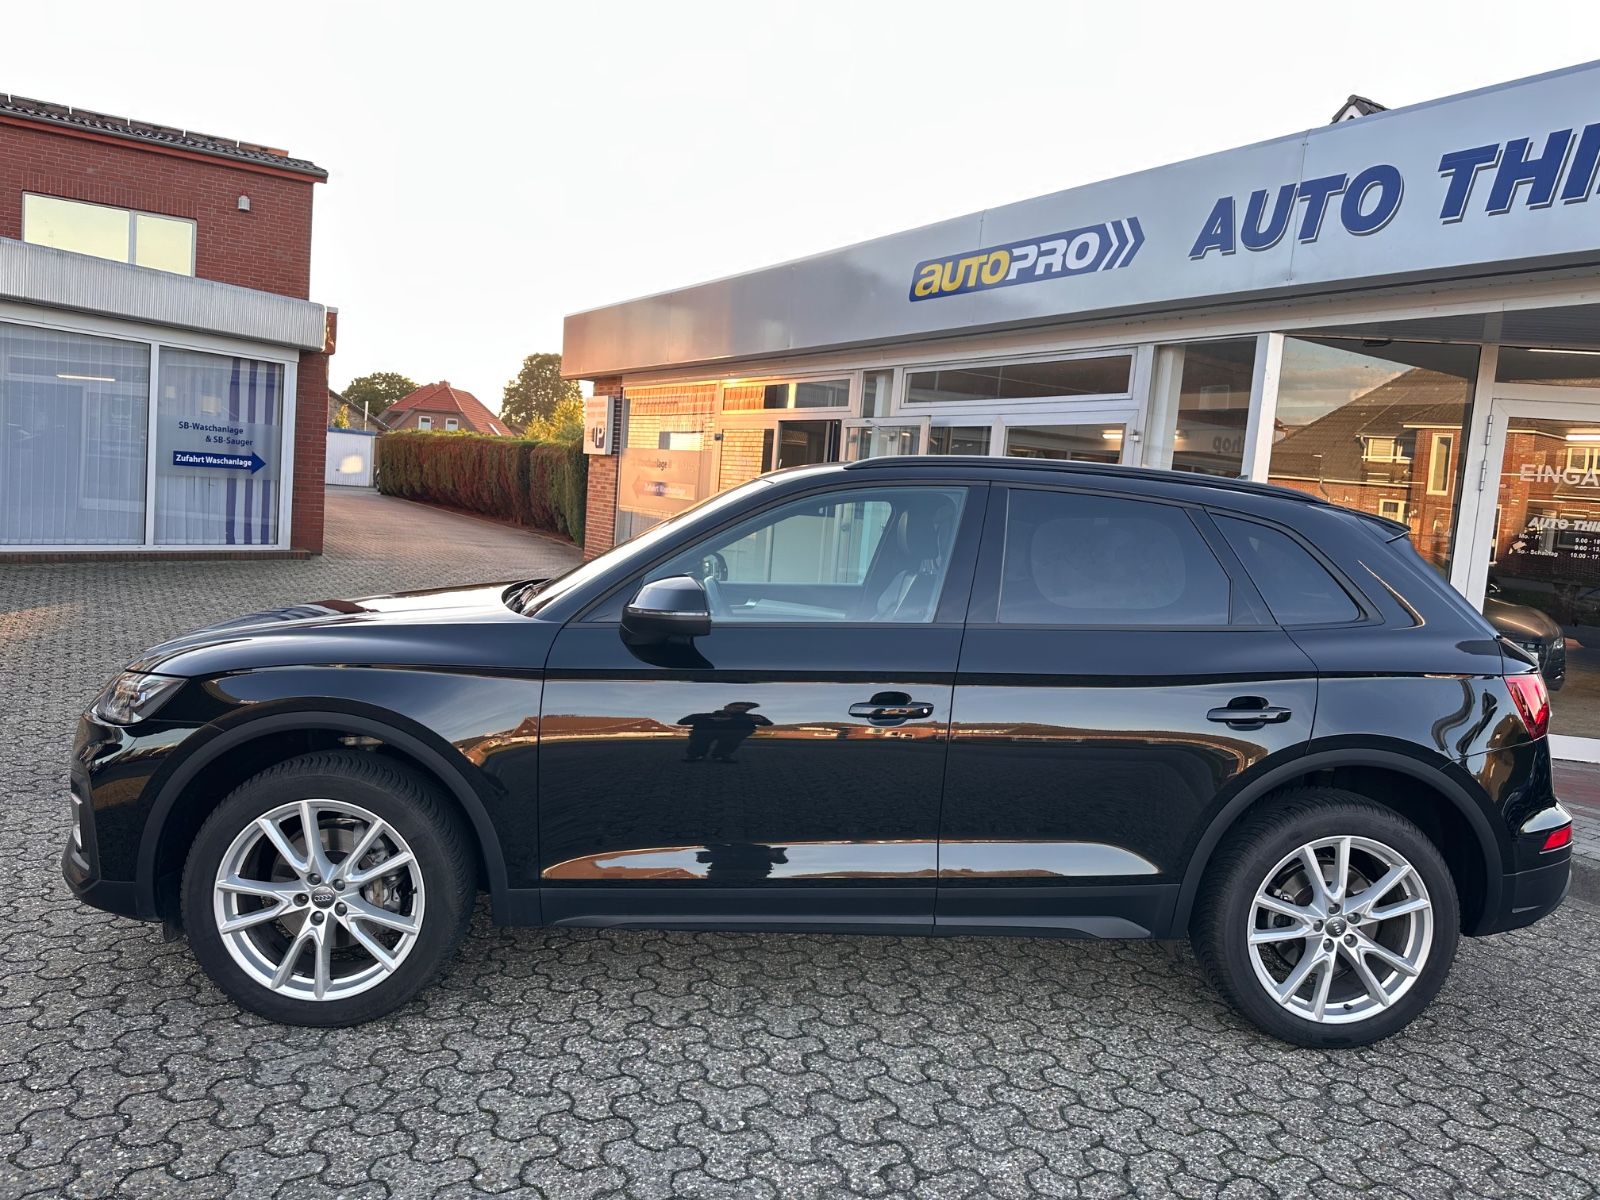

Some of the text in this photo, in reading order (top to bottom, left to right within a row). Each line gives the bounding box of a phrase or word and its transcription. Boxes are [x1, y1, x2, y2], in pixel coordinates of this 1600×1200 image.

[1188, 122, 1600, 261] AUTO THI
[178, 421, 244, 435] SB-Waschanlage
[205, 435, 254, 446] & SB-Sauger
[175, 454, 252, 467] Zufahrt Waschanlage
[1520, 463, 1599, 486] EINGA
[1528, 517, 1569, 530] AUTO
